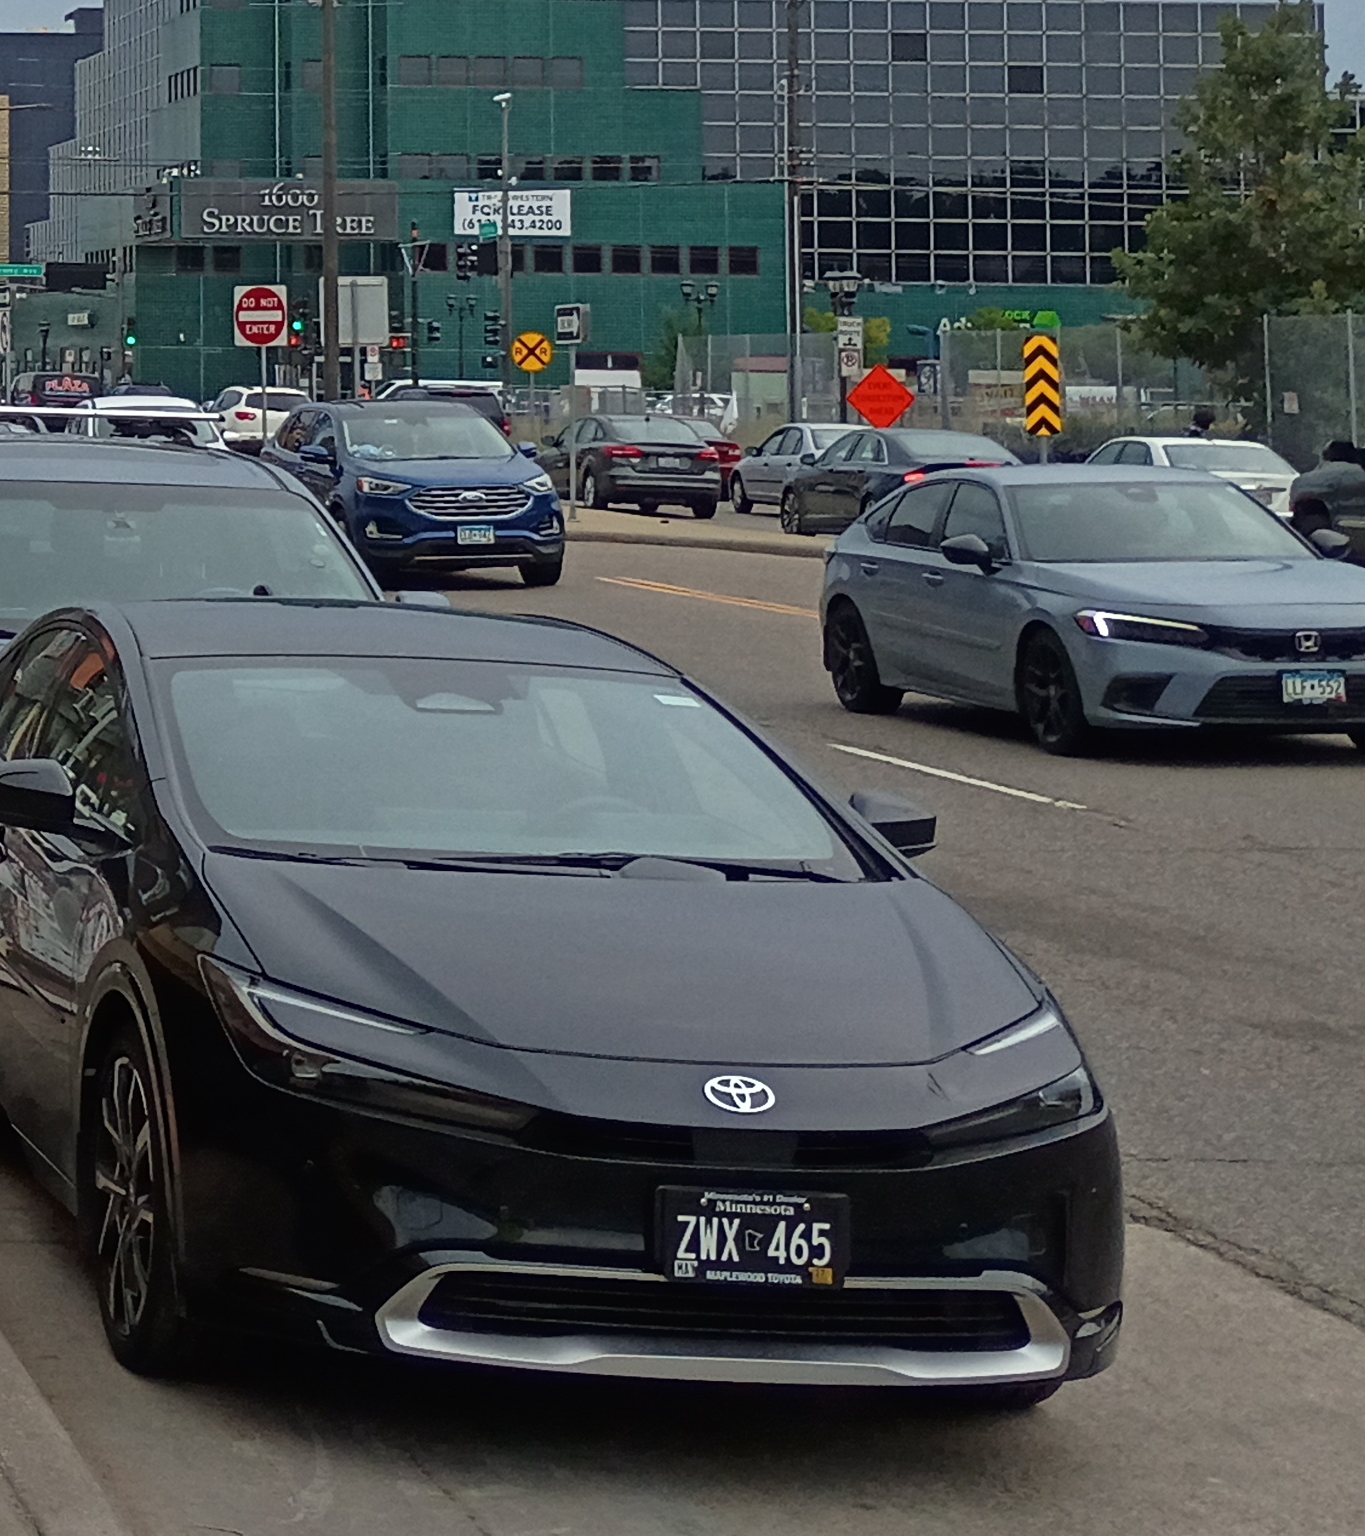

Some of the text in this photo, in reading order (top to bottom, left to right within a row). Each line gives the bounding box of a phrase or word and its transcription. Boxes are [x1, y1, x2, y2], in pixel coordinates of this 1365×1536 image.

[259, 182, 320, 207] 1600
[509, 205, 553, 216] LEASE
[242, 297, 279, 307] DO NOT
[245, 324, 276, 334] ENTER
[515, 347, 548, 356] R R
[715, 1200, 795, 1216] Minnesota
[676, 1215, 832, 1267] ZWX 465
